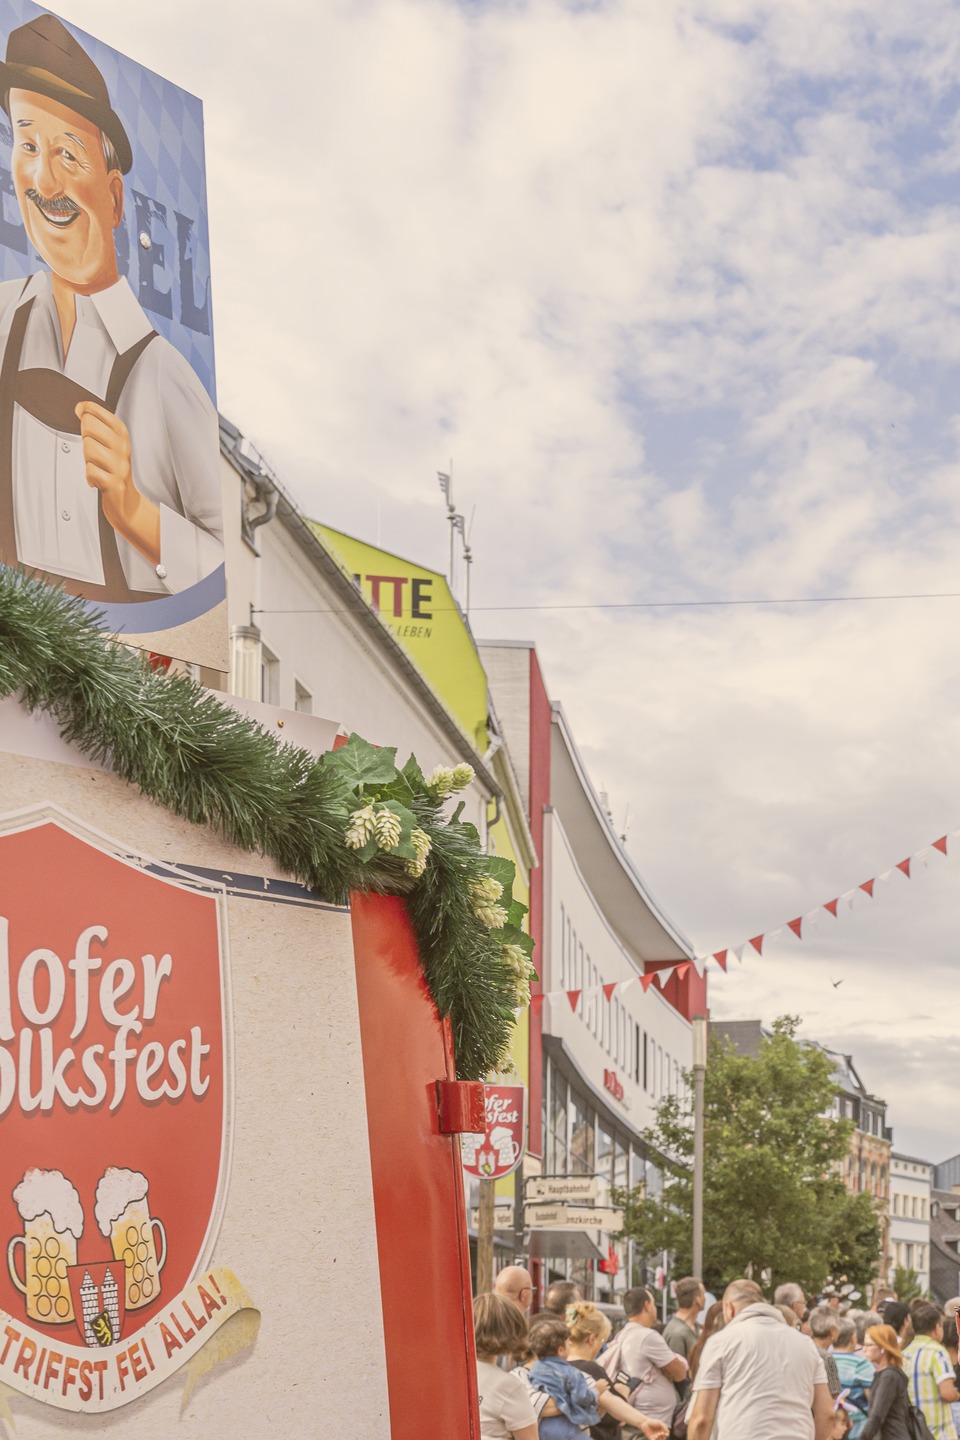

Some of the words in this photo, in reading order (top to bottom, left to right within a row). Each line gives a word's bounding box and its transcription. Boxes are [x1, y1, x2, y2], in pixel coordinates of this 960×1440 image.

[0, 1325, 109, 1401] TRIFFST
[115, 1337, 156, 1391] FEI
[159, 1274, 228, 1359] ALLA!
